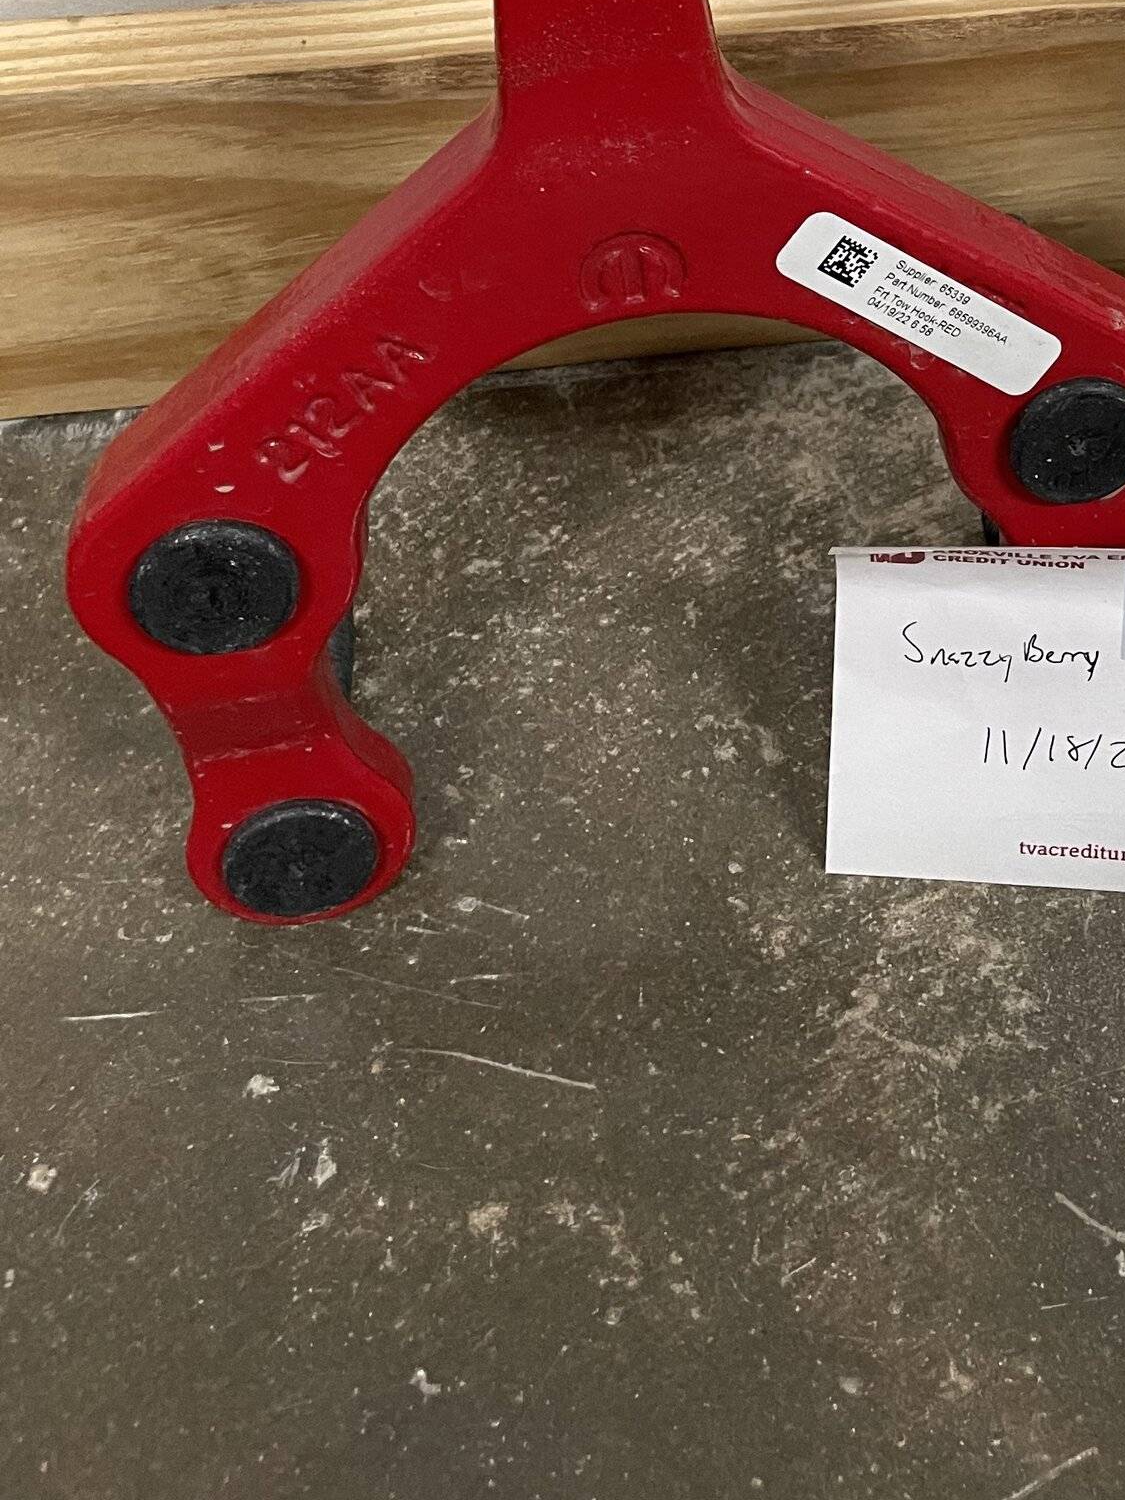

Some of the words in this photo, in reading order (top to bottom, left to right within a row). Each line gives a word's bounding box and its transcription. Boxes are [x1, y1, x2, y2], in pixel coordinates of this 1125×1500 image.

[884, 272, 907, 290] Part
[948, 307, 1008, 345] 68599396AA
[939, 283, 971, 305] 65339
[867, 296, 911, 325] 04/19/22
[873, 285, 890, 300] Frt
[890, 294, 911, 311] Tow
[910, 305, 962, 337] Hook-RED
[933, 555, 1009, 565] CREDIT
[1017, 558, 1085, 569] UNION
